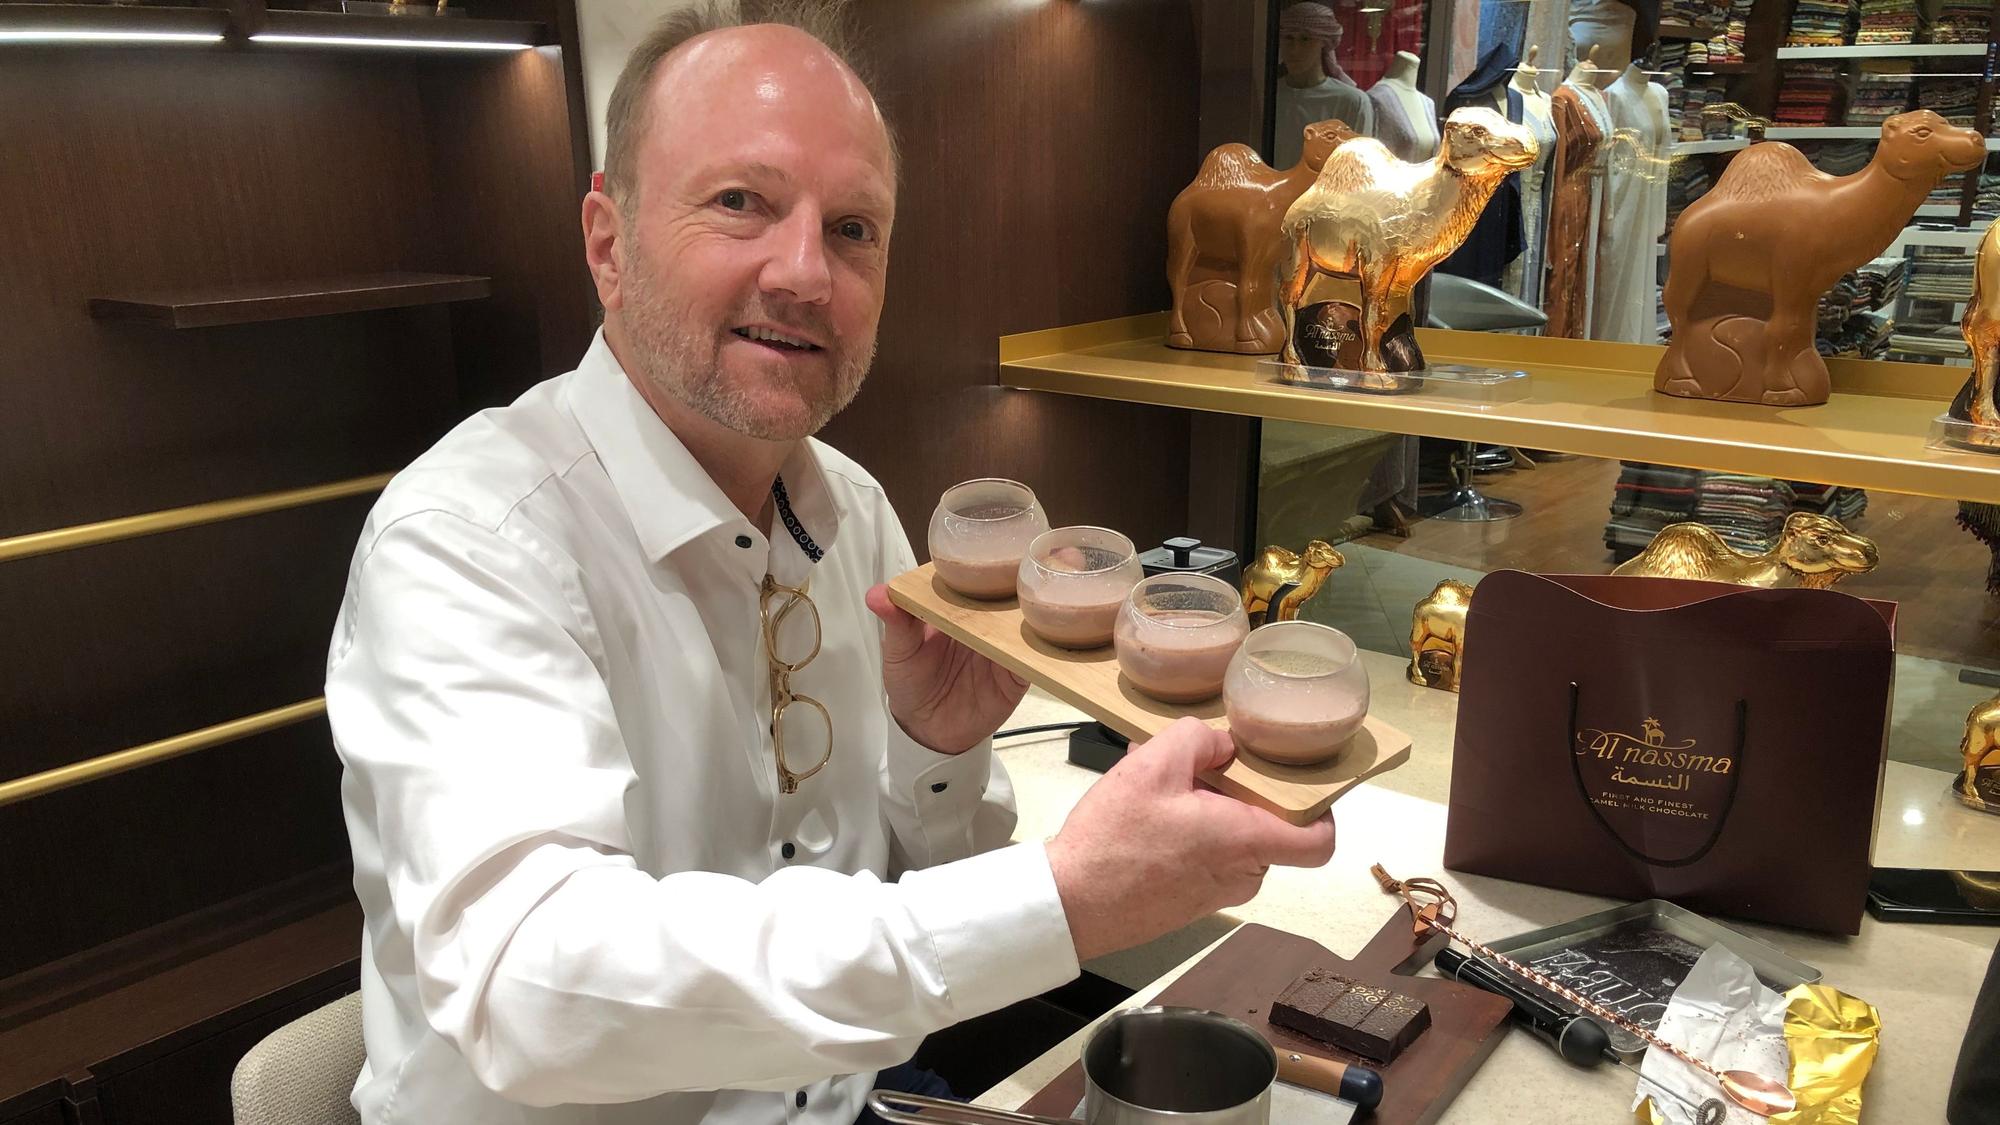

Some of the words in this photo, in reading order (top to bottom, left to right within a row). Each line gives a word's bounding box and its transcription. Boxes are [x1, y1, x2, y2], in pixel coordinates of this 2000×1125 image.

[1575, 728, 1620, 760] Al
[1622, 747, 1732, 774] nassma
[1610, 765, 1690, 792] النسمة
[1633, 796, 1654, 804] AND
[1657, 799, 1695, 809] FINEST
[1648, 806, 1710, 819] CHOCOLATE
